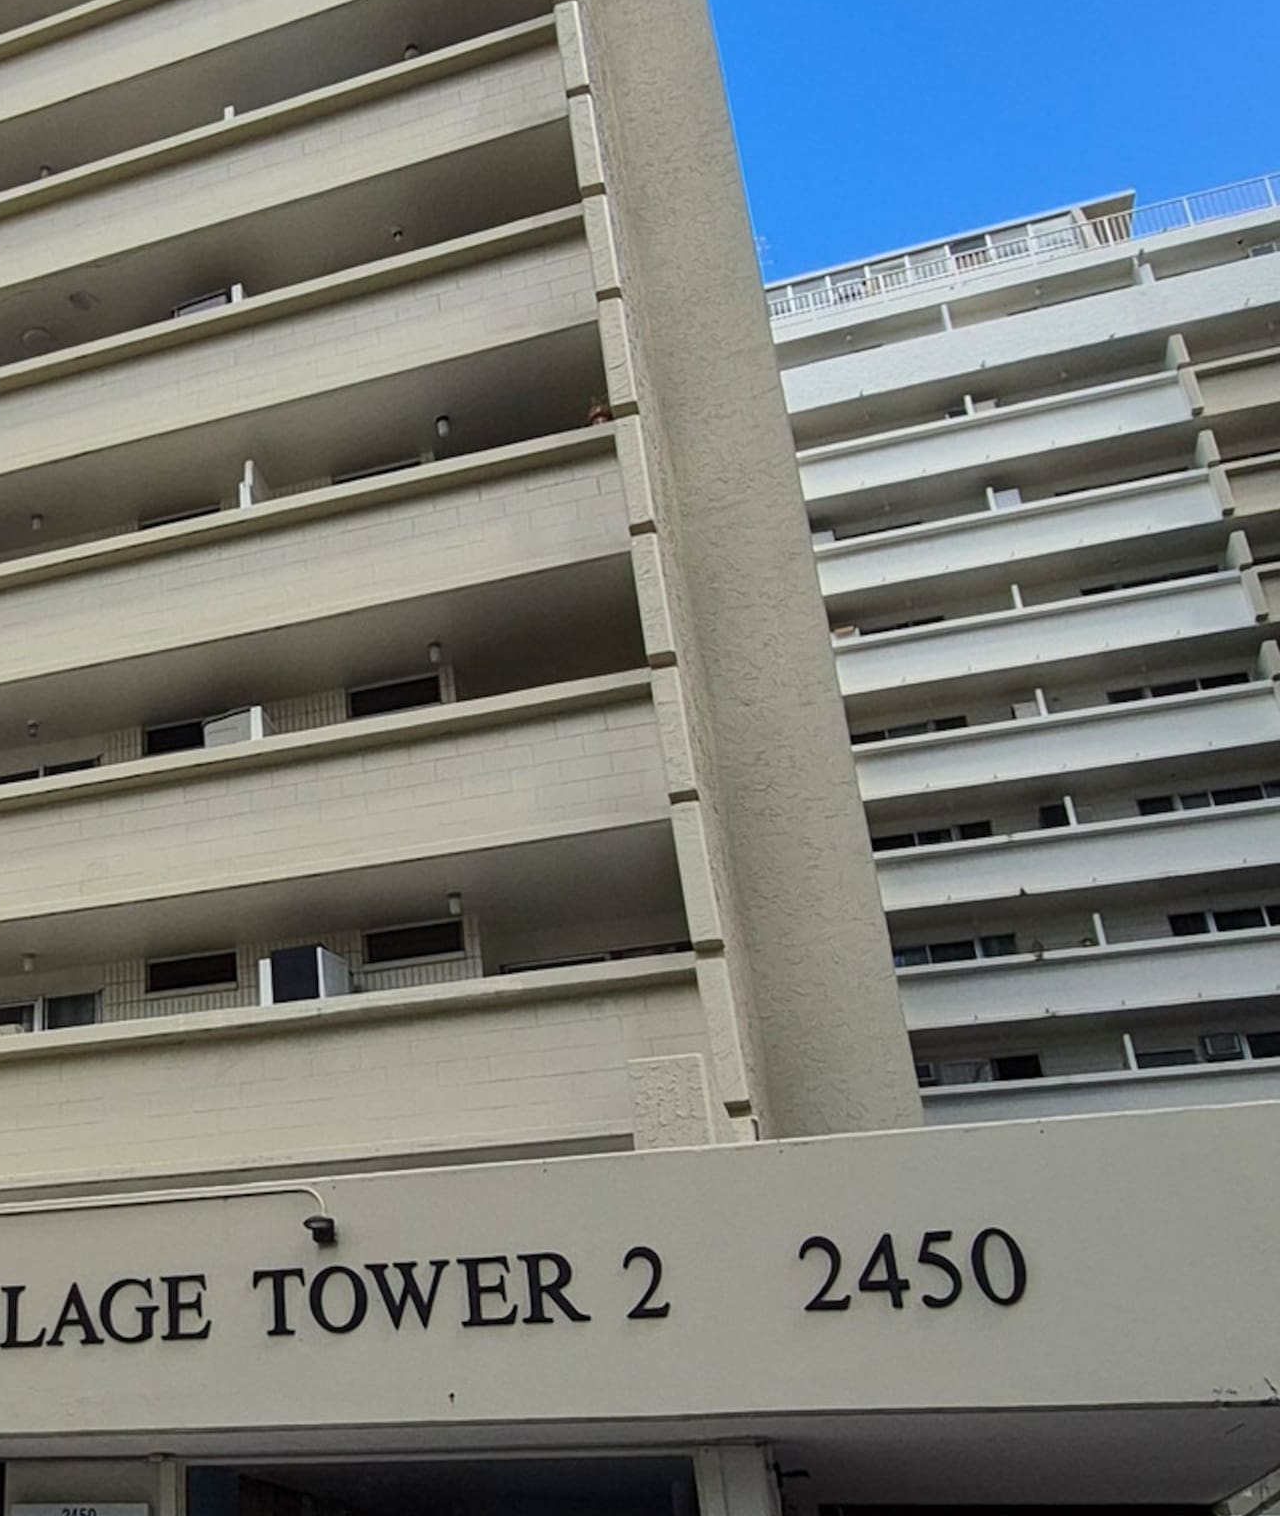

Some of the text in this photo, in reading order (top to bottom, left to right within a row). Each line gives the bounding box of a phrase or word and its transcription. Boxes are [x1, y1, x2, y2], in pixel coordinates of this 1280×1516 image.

[253, 1252, 591, 1337] TOWER
[623, 1246, 670, 1320] 2
[798, 1227, 1027, 1311] 2450
